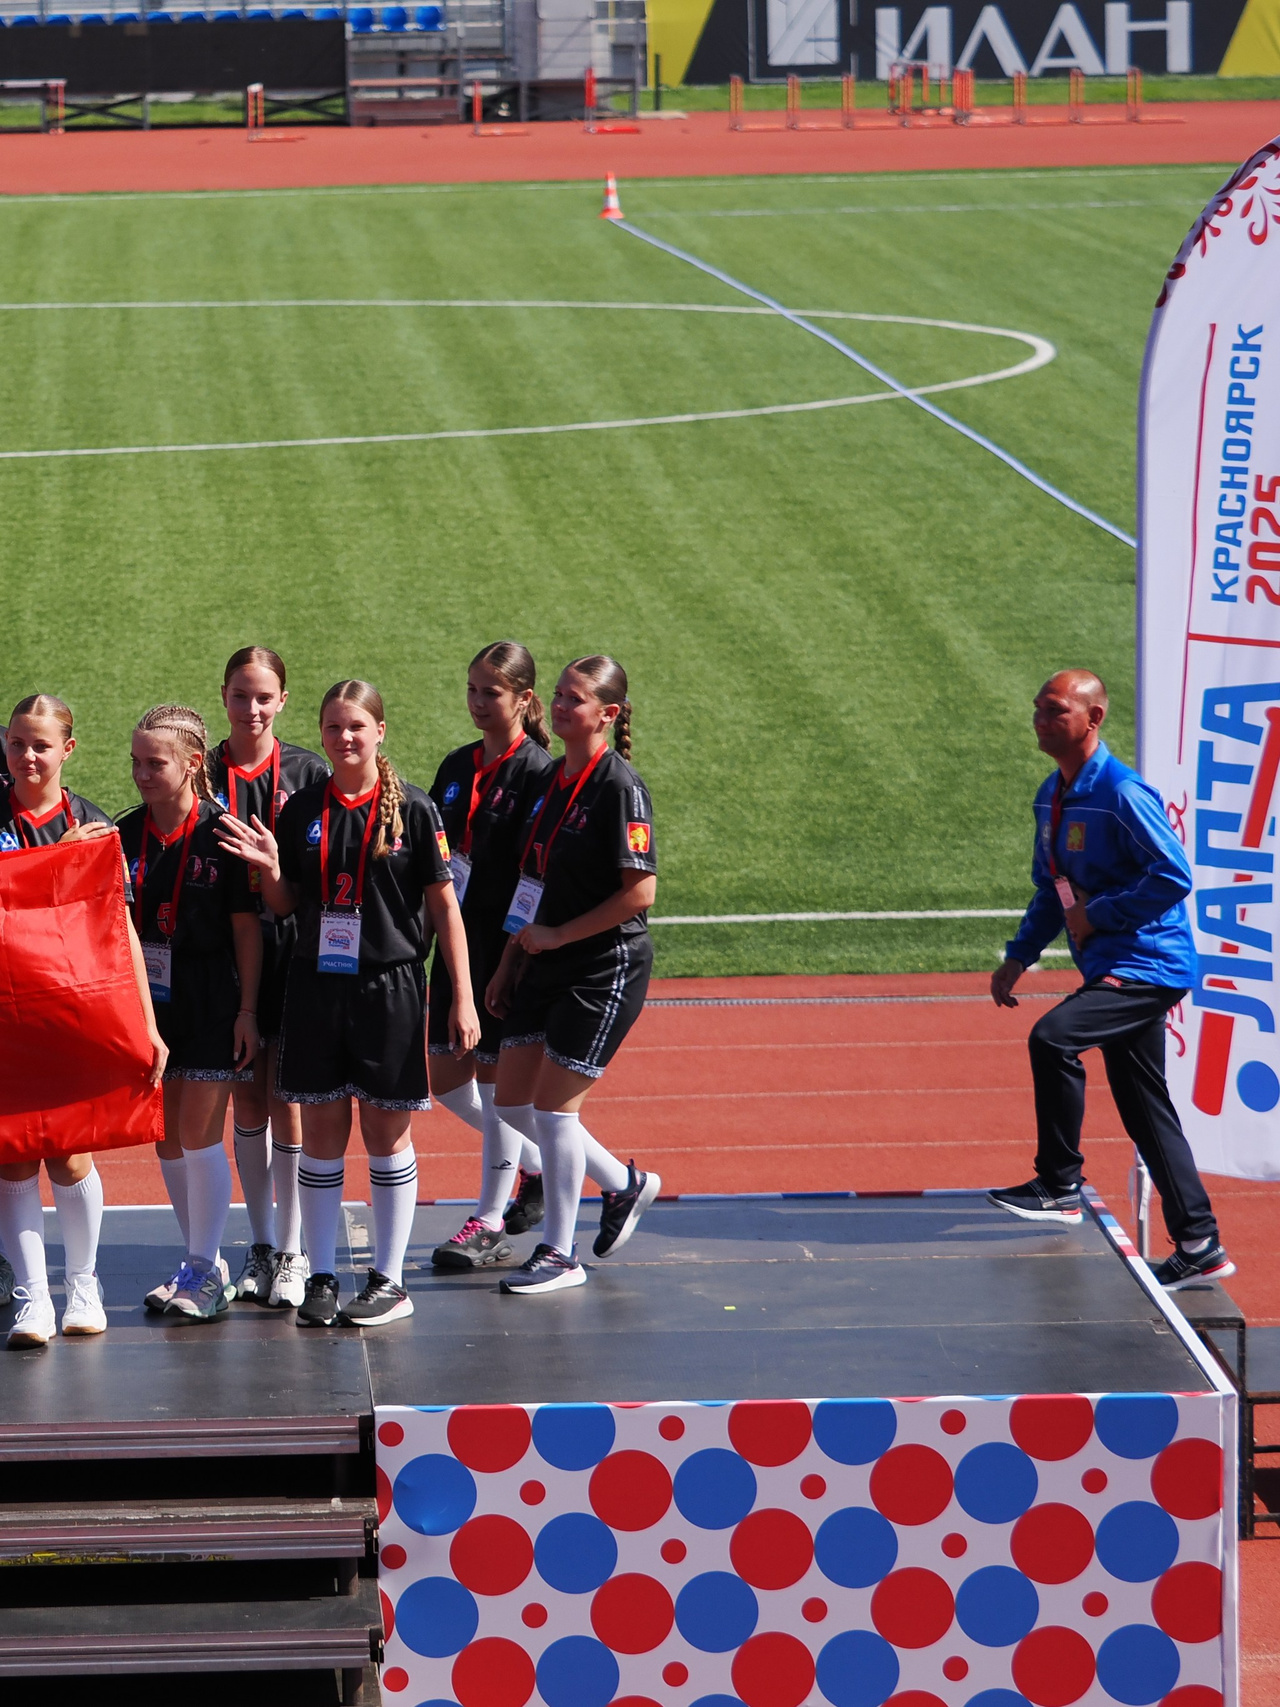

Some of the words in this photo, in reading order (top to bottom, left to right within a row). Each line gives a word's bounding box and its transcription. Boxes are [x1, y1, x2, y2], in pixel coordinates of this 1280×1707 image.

[875, 1, 1191, 80] ИЛАН
[1210, 323, 1264, 603] КРАСНОЯРСК
[1245, 473, 1280, 607] 2025
[334, 872, 353, 906] 2
[1192, 682, 1280, 1034] ЛАПТА
[157, 902, 176, 936] 5
[322, 960, 353, 969] УЧАСТНИК
